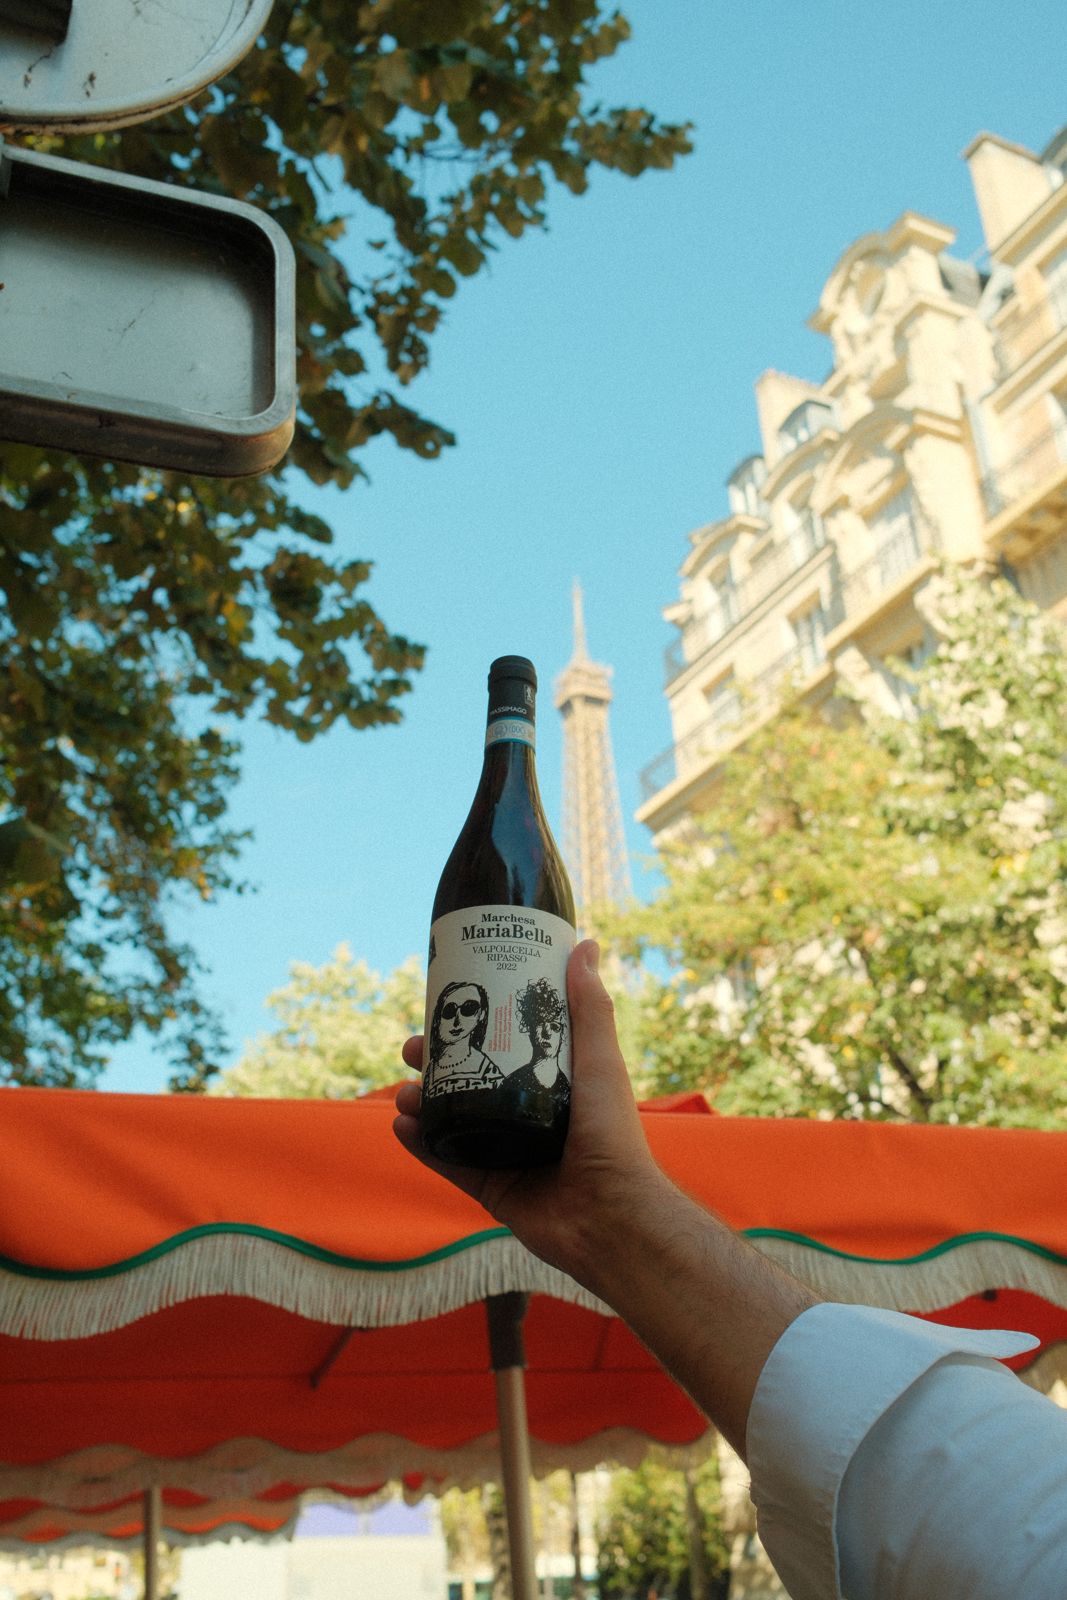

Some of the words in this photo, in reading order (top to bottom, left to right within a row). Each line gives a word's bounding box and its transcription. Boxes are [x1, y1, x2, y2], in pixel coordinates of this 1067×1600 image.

[481, 914, 535, 925] Marchesa
[461, 924, 553, 946] MariaBella
[472, 945, 541, 957] VALPOLICELLA
[487, 953, 528, 963] RIPASSO
[496, 962, 517, 971] 2022
